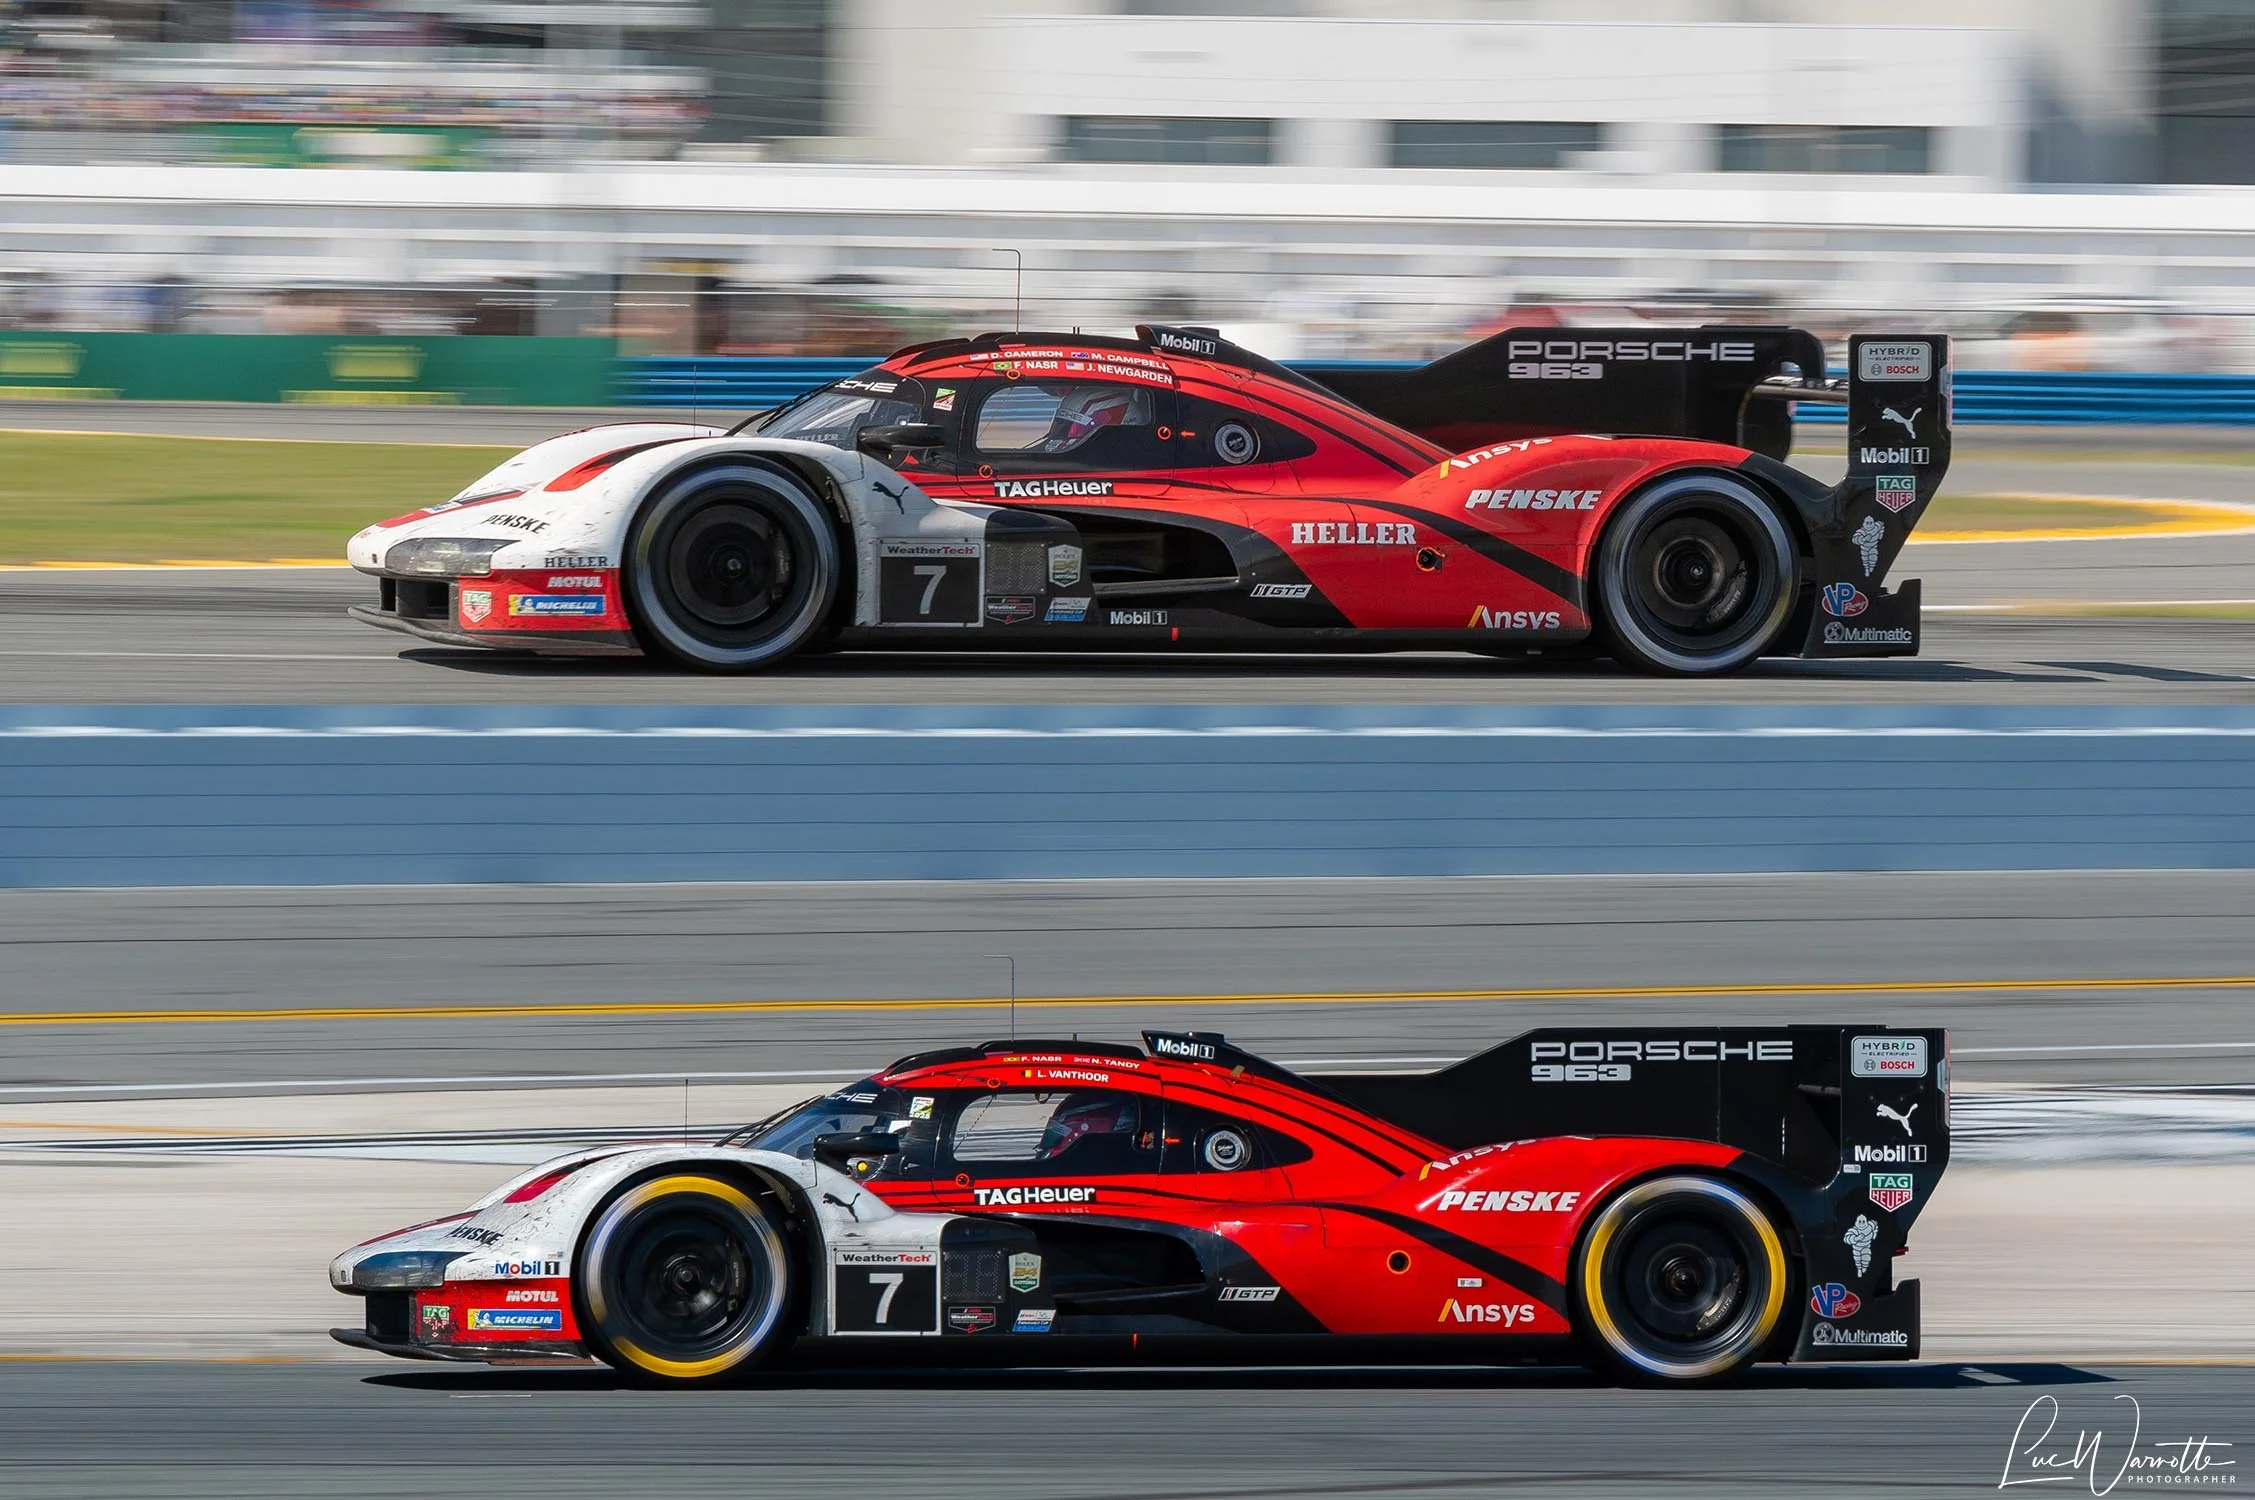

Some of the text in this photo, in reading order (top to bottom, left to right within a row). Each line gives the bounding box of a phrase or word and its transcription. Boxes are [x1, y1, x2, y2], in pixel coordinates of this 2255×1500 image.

[1160, 333, 1200, 352] Mobil
[1508, 341, 1755, 361] PORSCHE
[1014, 361, 1058, 369] F. NASR
[1091, 353, 1170, 370] M. CAMPBELL
[1086, 364, 1173, 384] J. NEWGARDEN
[1508, 363, 1603, 379] 963
[1886, 366, 1919, 374] BOSCH
[1440, 438, 1552, 479] Ansys
[1860, 448, 1909, 463] Mobil
[1880, 479, 1911, 489] TAG
[1465, 489, 1602, 510] PENSKE
[1879, 493, 1913, 509] HEUER
[480, 514, 551, 534] PENSKE
[1291, 523, 1416, 544] HELLER
[887, 546, 975, 555] WeatherTech
[547, 576, 602, 587] MOTUL
[913, 566, 947, 614] 7
[1270, 587, 1306, 596] GTP
[535, 601, 598, 610] MICHELIN
[1823, 583, 1856, 616] VP
[1110, 611, 1150, 625] Mobil
[1467, 605, 1560, 630] Ansys
[1844, 627, 1912, 641] Multimatic
[1157, 1039, 1199, 1057] Mobil
[1531, 1041, 1793, 1061] PORSCHE
[1104, 1059, 1140, 1069] TANDY
[1880, 1061, 1915, 1069] BOSCH
[1037, 1070, 1109, 1083] L. VANTHOOR
[1531, 1064, 1631, 1081] 963
[1418, 1139, 1537, 1181] Ansys
[1854, 1145, 1905, 1162] Mobil
[1874, 1177, 1908, 1188] TAG
[1437, 1191, 1580, 1211] PENSKE
[1872, 1191, 1910, 1209] HEUER
[843, 1254, 931, 1262] WeatherTech
[495, 1261, 560, 1275] Mobil 1
[506, 1290, 559, 1302] MOTUL
[869, 1273, 904, 1324] 7
[1238, 1289, 1275, 1299] GTP
[1812, 1283, 1847, 1318] VP
[494, 1316, 553, 1324] MICHELIN
[1438, 1299, 1535, 1328] Ansys
[1834, 1330, 1908, 1343] Multimatic
